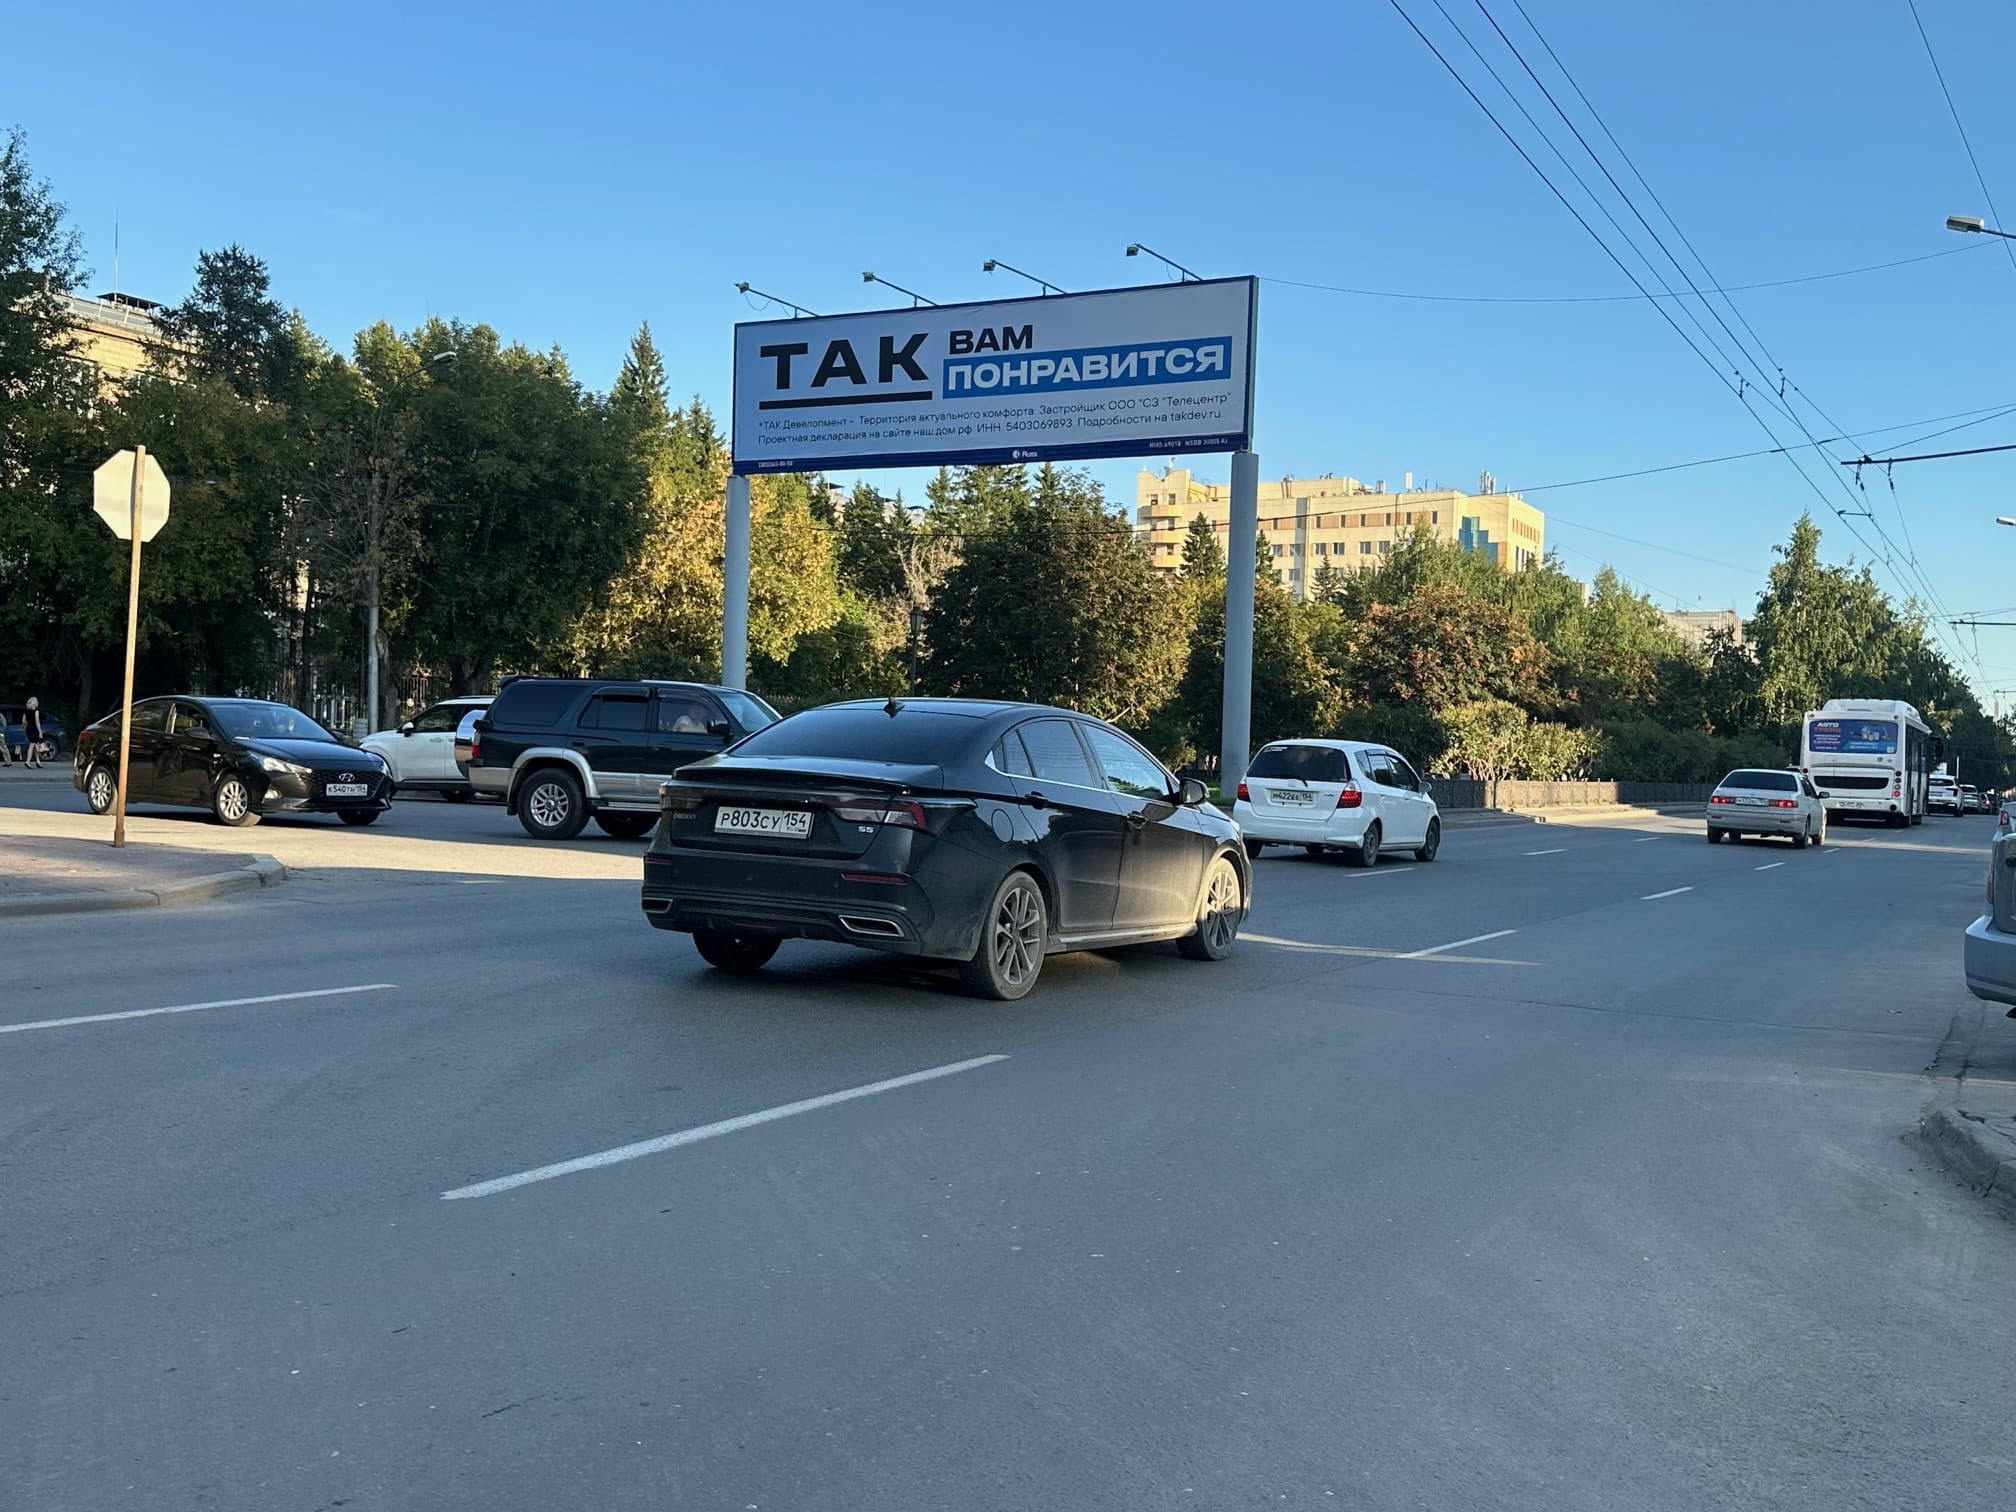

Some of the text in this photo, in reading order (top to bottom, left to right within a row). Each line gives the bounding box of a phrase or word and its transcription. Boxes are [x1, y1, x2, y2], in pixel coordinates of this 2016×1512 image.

[950, 325, 1033, 355] ВАМ
[760, 333, 929, 390] ТАК
[948, 344, 1225, 390] ПОНРАВИТСЯ
[758, 433, 809, 446] Проектная
[810, 430, 867, 443] декларация
[868, 430, 880, 439] на
[882, 427, 912, 438] сайте
[976, 423, 1001, 434] ИНН
[1006, 418, 1073, 432] 5403069893
[1077, 414, 1152, 428] Подробности
[1154, 414, 1168, 423] на
[783, 418, 847, 431] Девелопмент
[858, 415, 917, 427] Территория
[918, 410, 981, 423] актуального
[1039, 401, 1106, 416] Застройщик
[1108, 399, 1136, 411] ООО
[720, 810, 807, 829] Р803СУ 154
